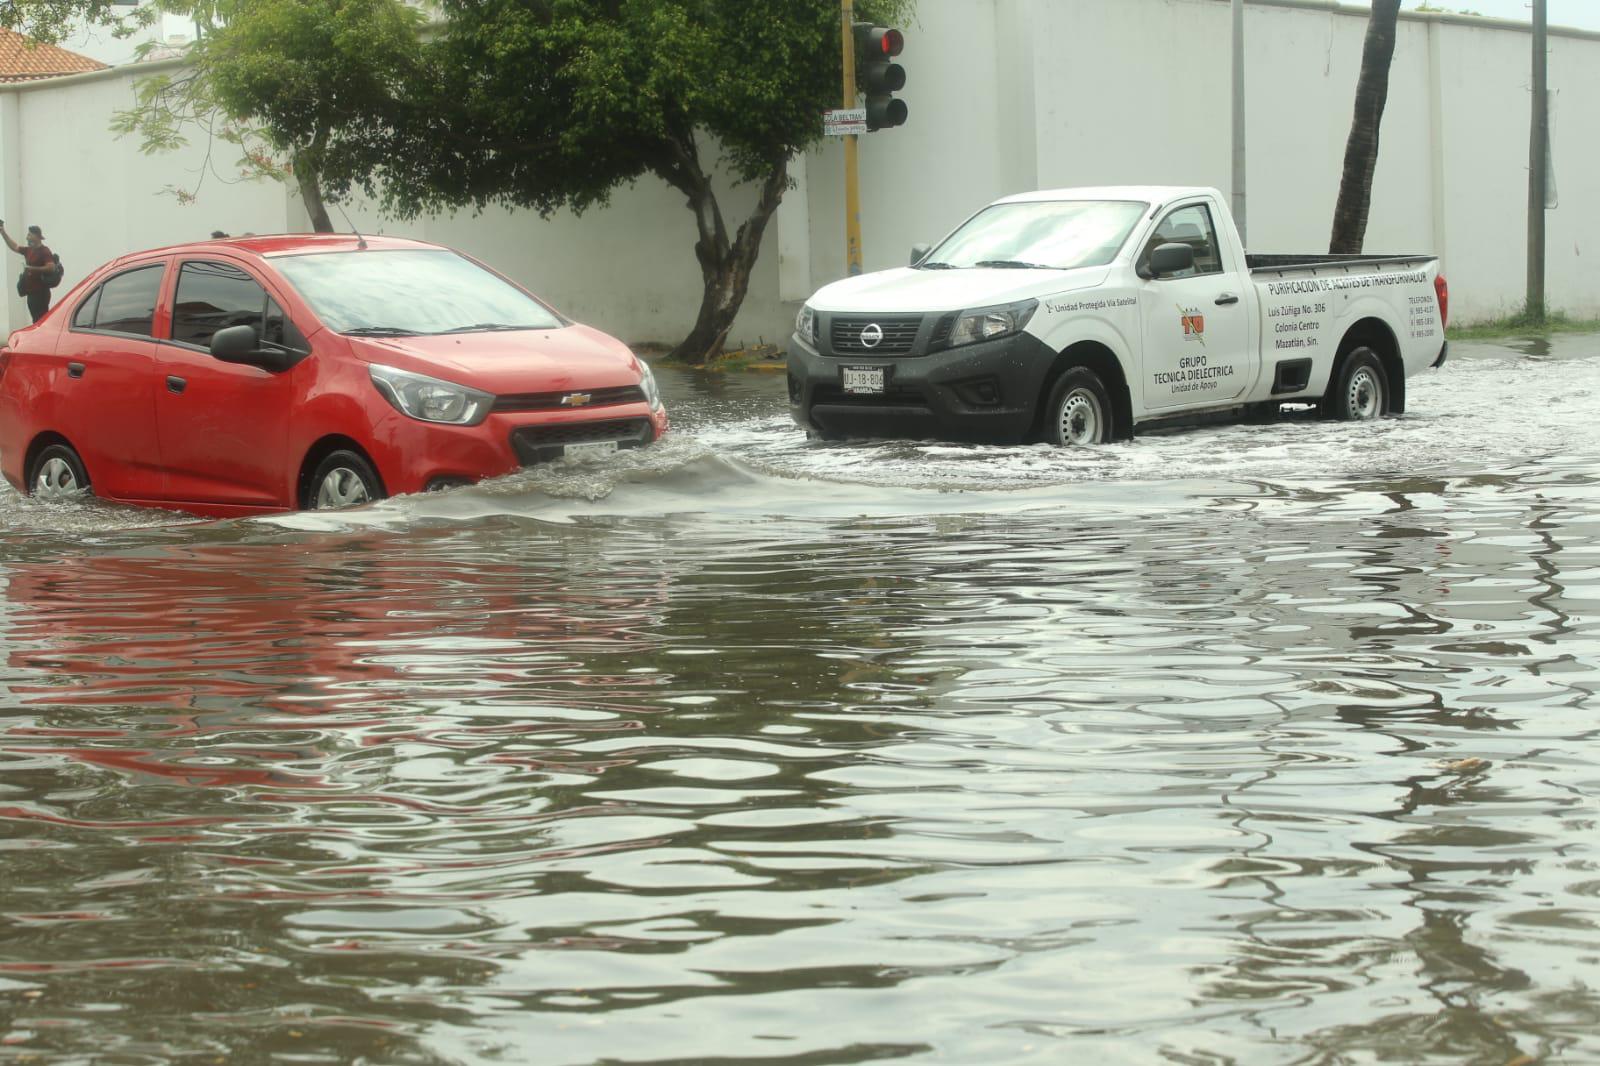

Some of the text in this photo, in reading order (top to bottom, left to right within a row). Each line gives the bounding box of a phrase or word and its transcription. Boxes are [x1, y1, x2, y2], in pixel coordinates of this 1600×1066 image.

[1320, 280, 1333, 291] DE
[1361, 276, 1370, 288] DE
[1055, 302, 1078, 312] Unidad
[1079, 300, 1106, 310] Protegida
[1268, 308, 1280, 317] Luis
[1314, 303, 1326, 313] 306
[1275, 321, 1320, 333] Colonia Centro
[1180, 355, 1207, 368] GRUPO
[1153, 365, 1233, 385] TECNICA DIELECTRICA
[1171, 380, 1218, 394] Unidad de Apoyo
